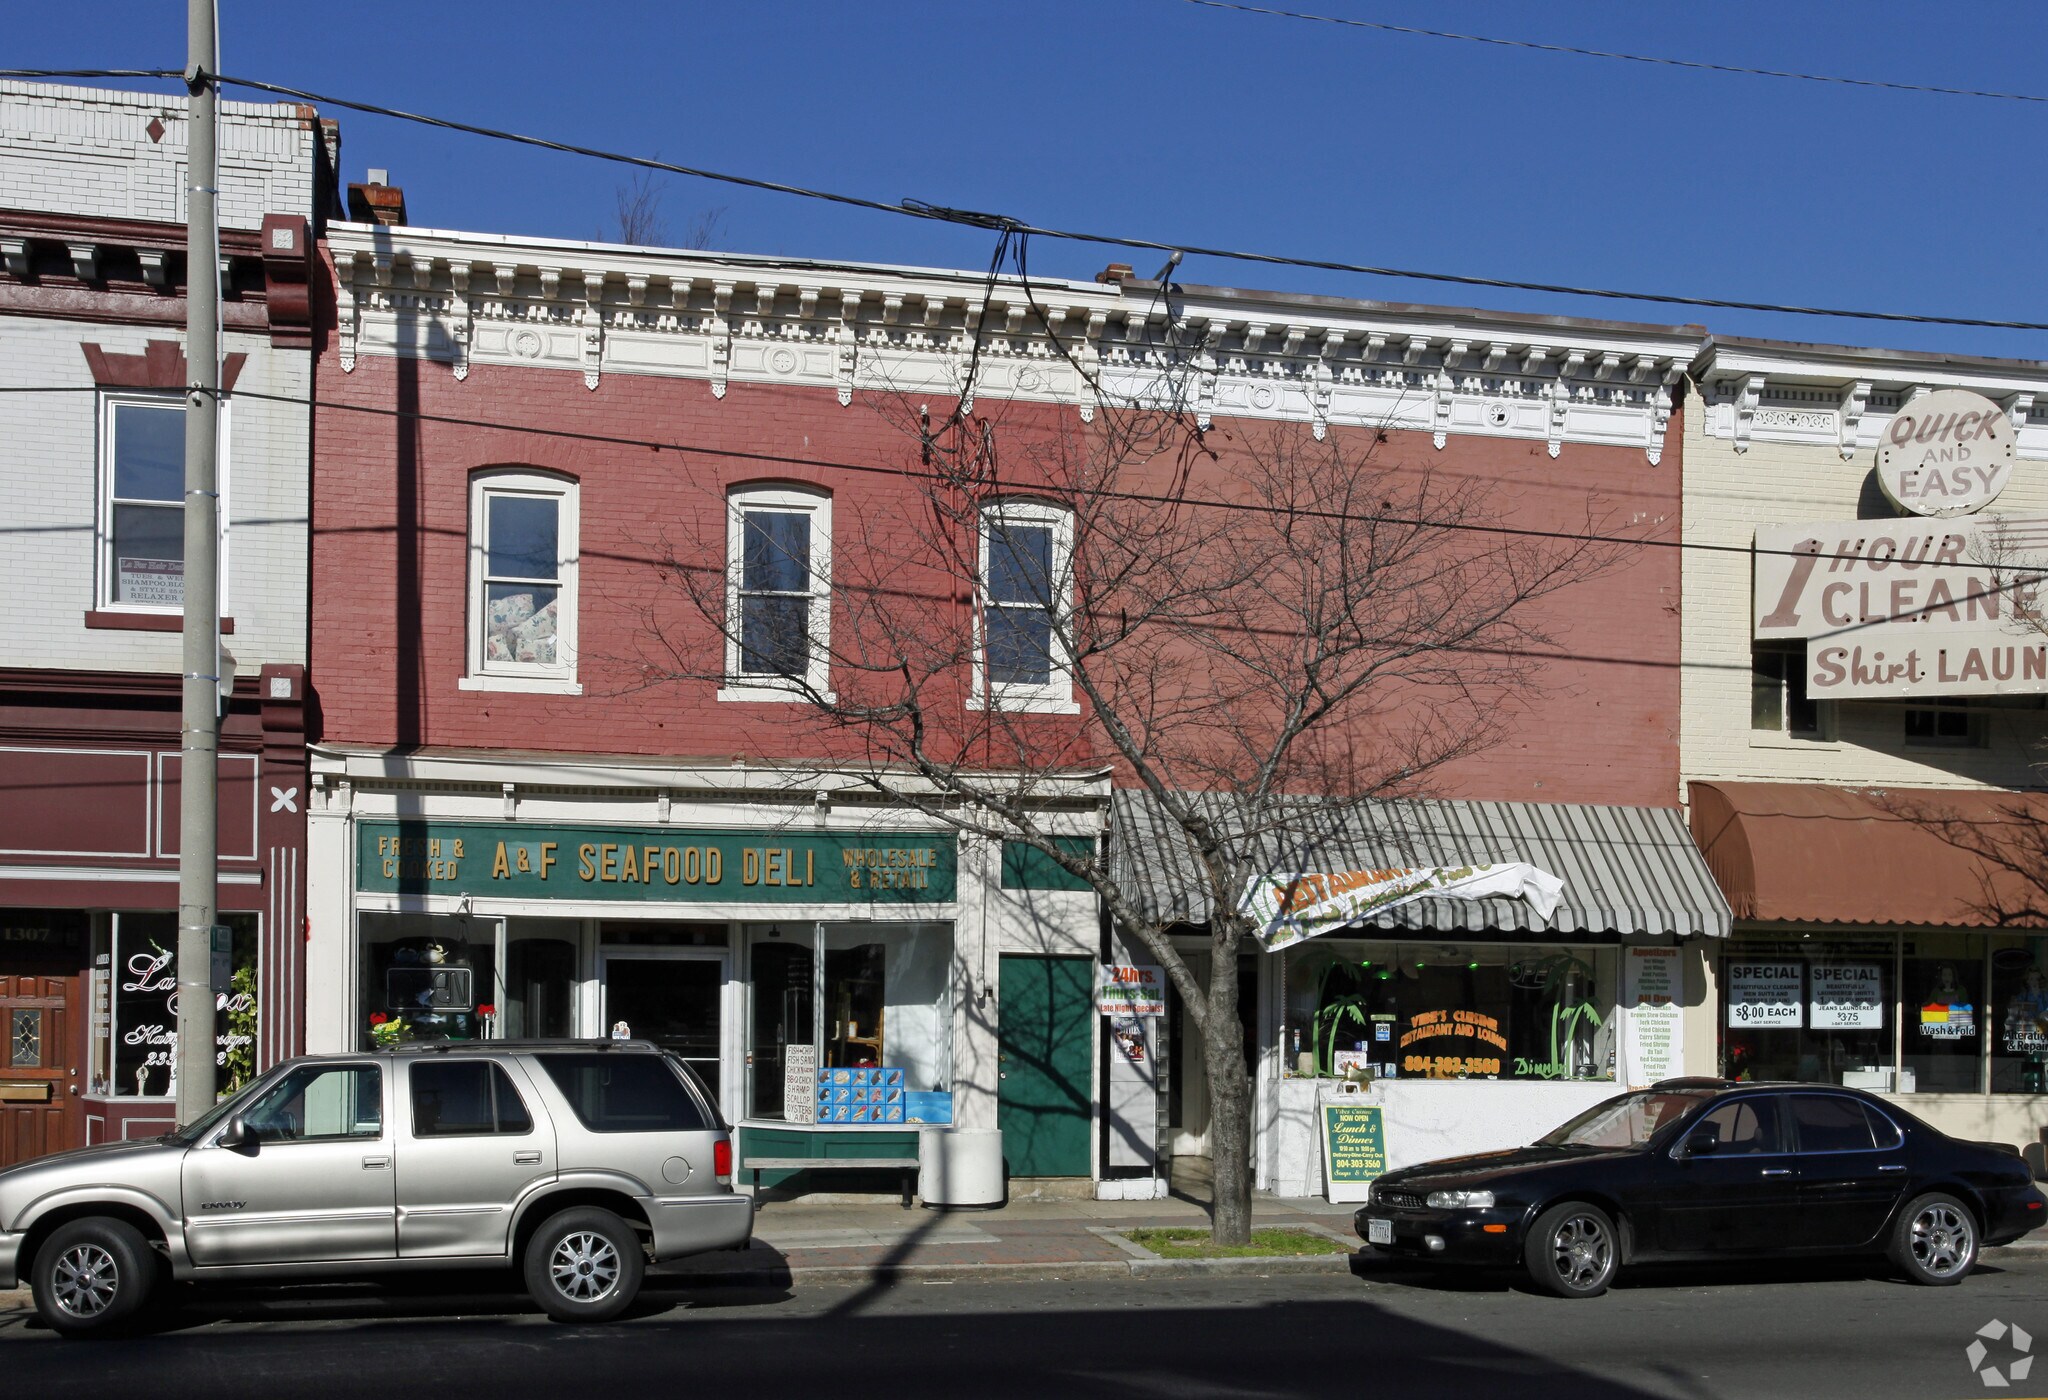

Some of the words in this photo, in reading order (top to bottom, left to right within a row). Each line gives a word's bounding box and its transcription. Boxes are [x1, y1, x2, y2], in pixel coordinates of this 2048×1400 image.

[1890, 409, 2003, 449] QUICK
[1921, 448, 1971, 463] AND
[1899, 466, 2002, 498] EASY
[1759, 537, 1824, 628] 1
[1827, 534, 1967, 573] HOUR
[131, 592, 178, 601] RELAXER
[1813, 645, 1923, 687] Shirt
[1938, 645, 2047, 683] LAUN
[379, 836, 441, 858] FRESH
[453, 838, 465, 859] &
[579, 843, 722, 885] SEAFOOD
[742, 847, 814, 887] DELI
[842, 847, 937, 869] WHOLESALE
[383, 859, 458, 880] COOKED
[850, 870, 861, 889] &
[870, 869, 928, 889] RETAIL
[1432, 867, 1473, 887] Food
[4, 928, 49, 941] 1307
[1632, 947, 1677, 957] Appetizers
[123, 953, 176, 992] La
[1111, 966, 1157, 983] 24hrs.
[1732, 966, 1799, 979] SPECIAL
[1813, 968, 1878, 980] SPECIAL
[1638, 994, 1651, 1002] All
[1653, 994, 1671, 1003] Day
[1100, 1003, 1114, 1012] Late
[1115, 1003, 1132, 1014] Night
[1132, 1003, 1163, 1014] Specials!
[1735, 1005, 1764, 1020] $8.00
[1767, 1008, 1796, 1016] EACH
[1411, 1010, 1447, 1028] VIBE'S
[1453, 1010, 1498, 1032] CUISINE
[1400, 1023, 1453, 1049] RESTAURANT
[1454, 1023, 1475, 1037] AND
[1477, 1027, 1507, 1051] LOUNGE
[1920, 1024, 1946, 1036] Wash
[1946, 1025, 1955, 1036] &
[1955, 1024, 1976, 1036] Fold
[2007, 1040, 2016, 1051] &
[788, 1056, 800, 1064] FISH
[800, 1056, 815, 1065] SAND
[1404, 1055, 1500, 1074] 804-303-3560
[787, 1085, 811, 1093] SHRIMP
[786, 1094, 811, 1105] SCALLOP
[786, 1104, 812, 1115] OYSTERS
[1332, 1122, 1366, 1133] Lunch
[1369, 1124, 1377, 1133] &
[1336, 1133, 1374, 1144] Dinner
[1336, 1159, 1381, 1168] 804-303-3560
[201, 1200, 248, 1210] ENVOY
